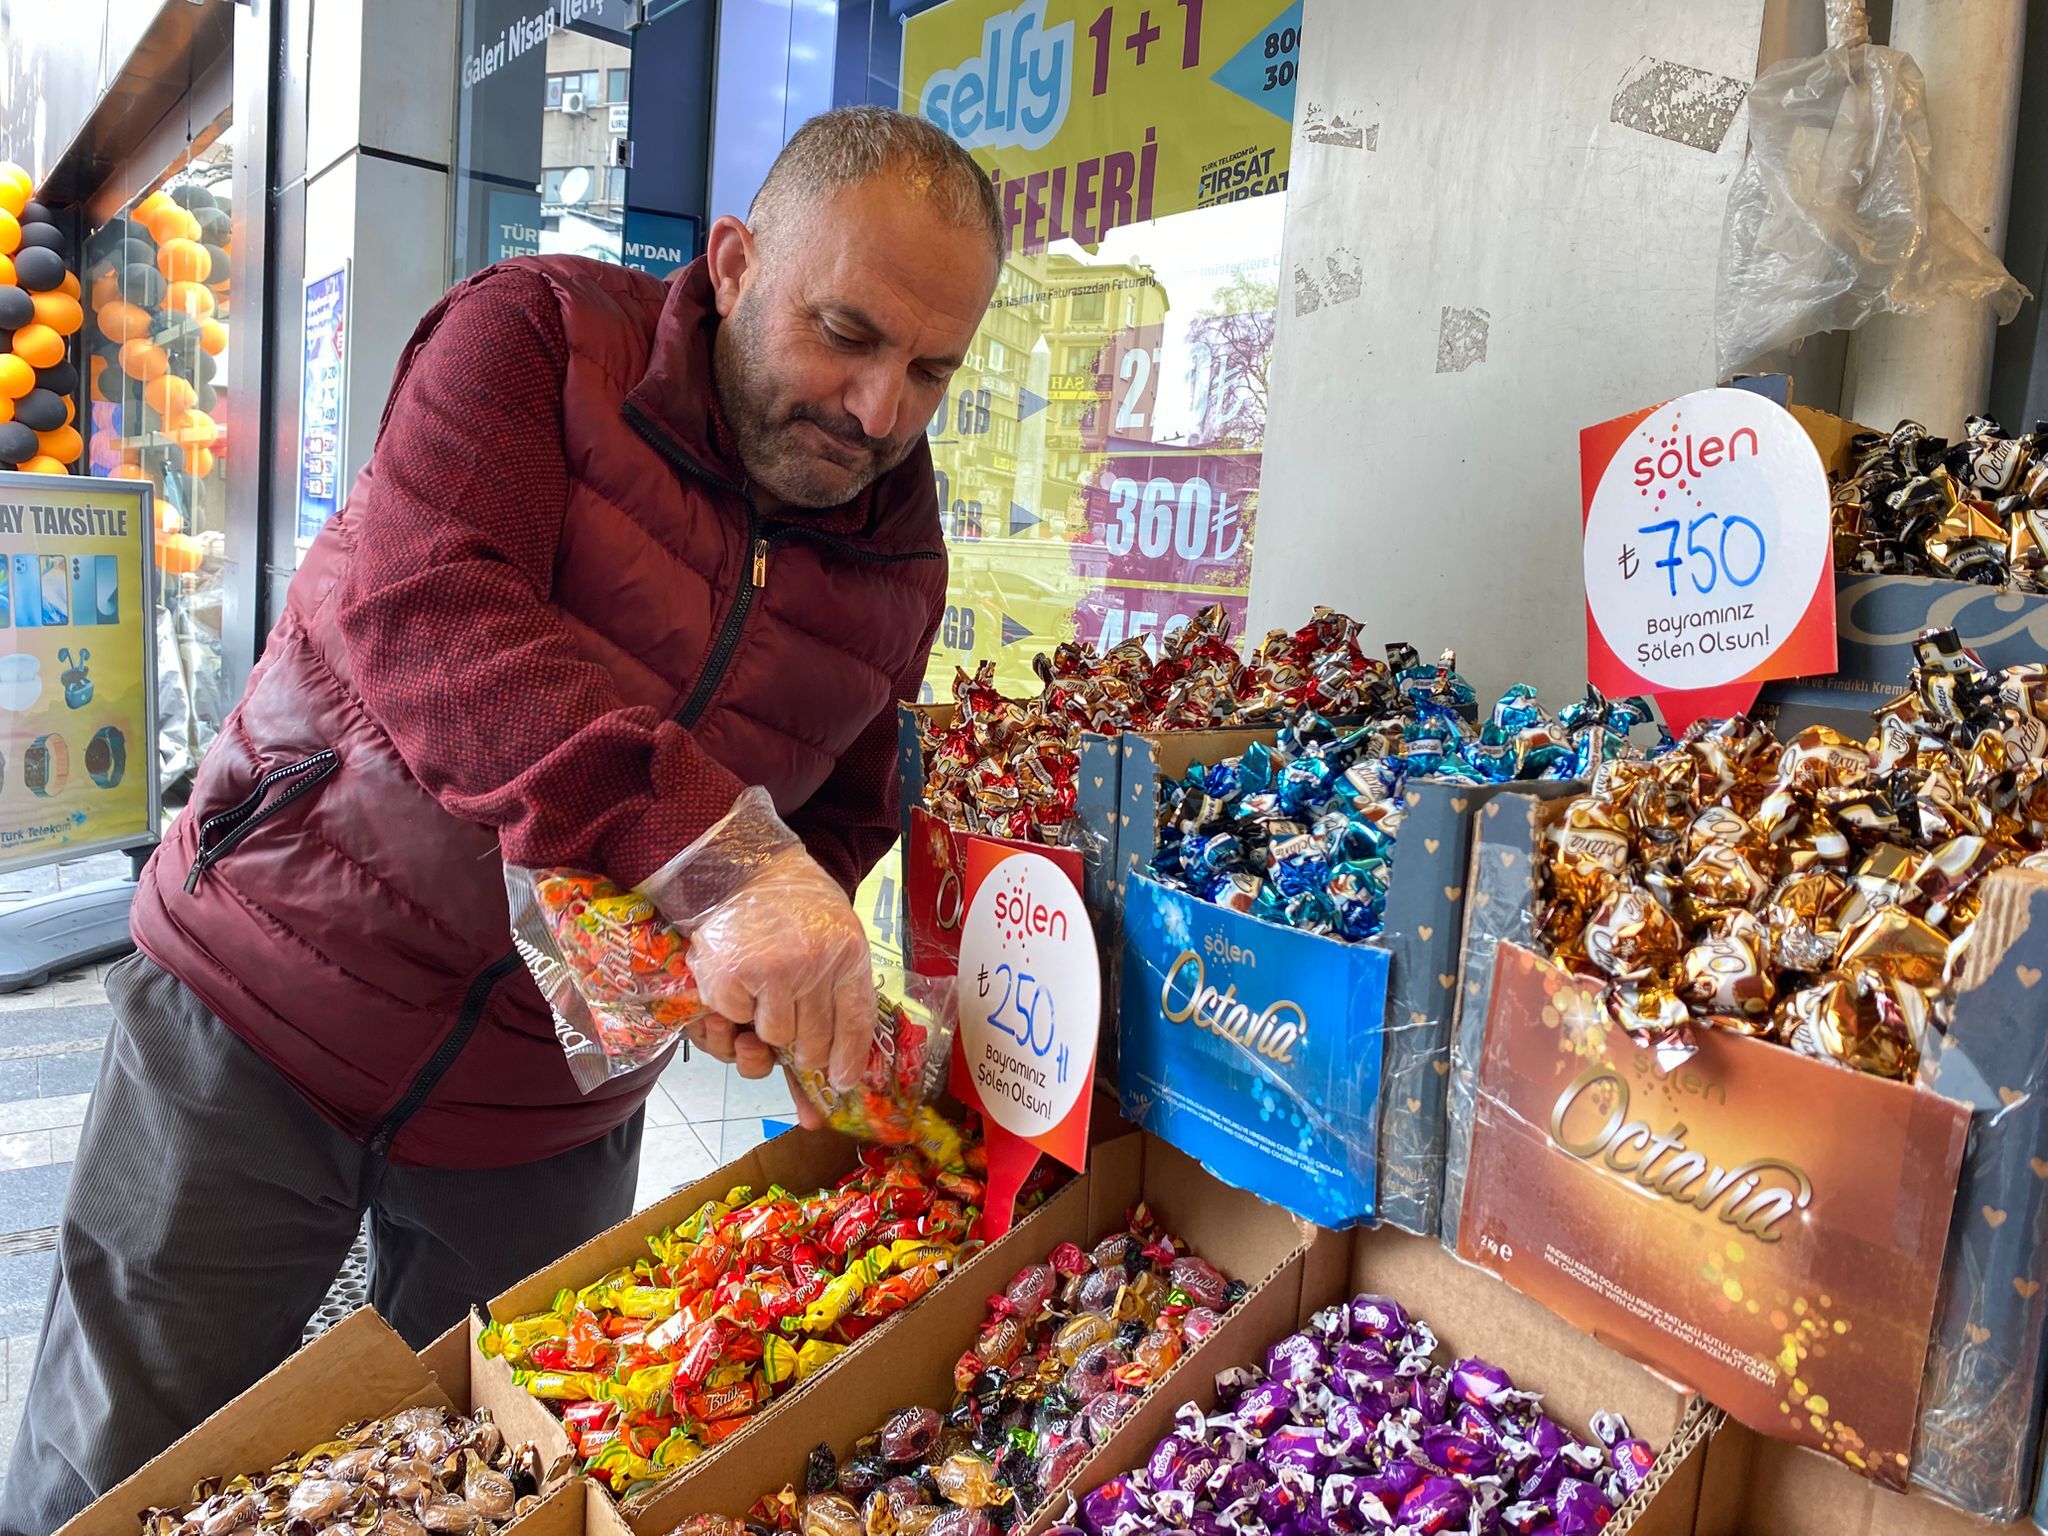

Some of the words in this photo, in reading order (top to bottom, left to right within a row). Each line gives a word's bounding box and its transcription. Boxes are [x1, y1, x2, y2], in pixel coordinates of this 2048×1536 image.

[463, 31, 505, 89] Galeri
[508, 6, 555, 62] Nisan
[926, 12, 1064, 135] selfy
[1199, 147, 1276, 199] FIRSAT
[1048, 281, 1110, 301] Faturasızdan
[1112, 274, 1161, 292] Faturalıy
[29, 504, 128, 537] TAKSİTLE
[1647, 603, 1755, 638] Bayramınız
[1637, 641, 1695, 667] Şölen
[1699, 624, 1770, 655] Olsun!
[1827, 677, 1868, 693] Fındıklı
[28, 821, 72, 838] Telekom
[1161, 949, 1307, 1065] Octavia
[986, 1043, 1046, 1089] Bayramınız
[978, 1064, 1010, 1100] Şölen
[1011, 1081, 1052, 1121] Olsun!
[1550, 1063, 1813, 1243] Octavia
[1181, 1269, 1218, 1296] Butik
[1598, 1275, 1636, 1302] DOLGULU
[1560, 1262, 1604, 1294] CHOCOLATE
[1604, 1289, 1626, 1308] WITH
[1626, 1302, 1654, 1322] CRISPY
[1654, 1315, 1673, 1333] RICE
[1672, 1328, 1694, 1344] AND
[1694, 1338, 1742, 1369] HAZELNUT
[1743, 1364, 1777, 1388] CREAM
[706, 1384, 742, 1414] Butik
[896, 1405, 924, 1436] Butik
